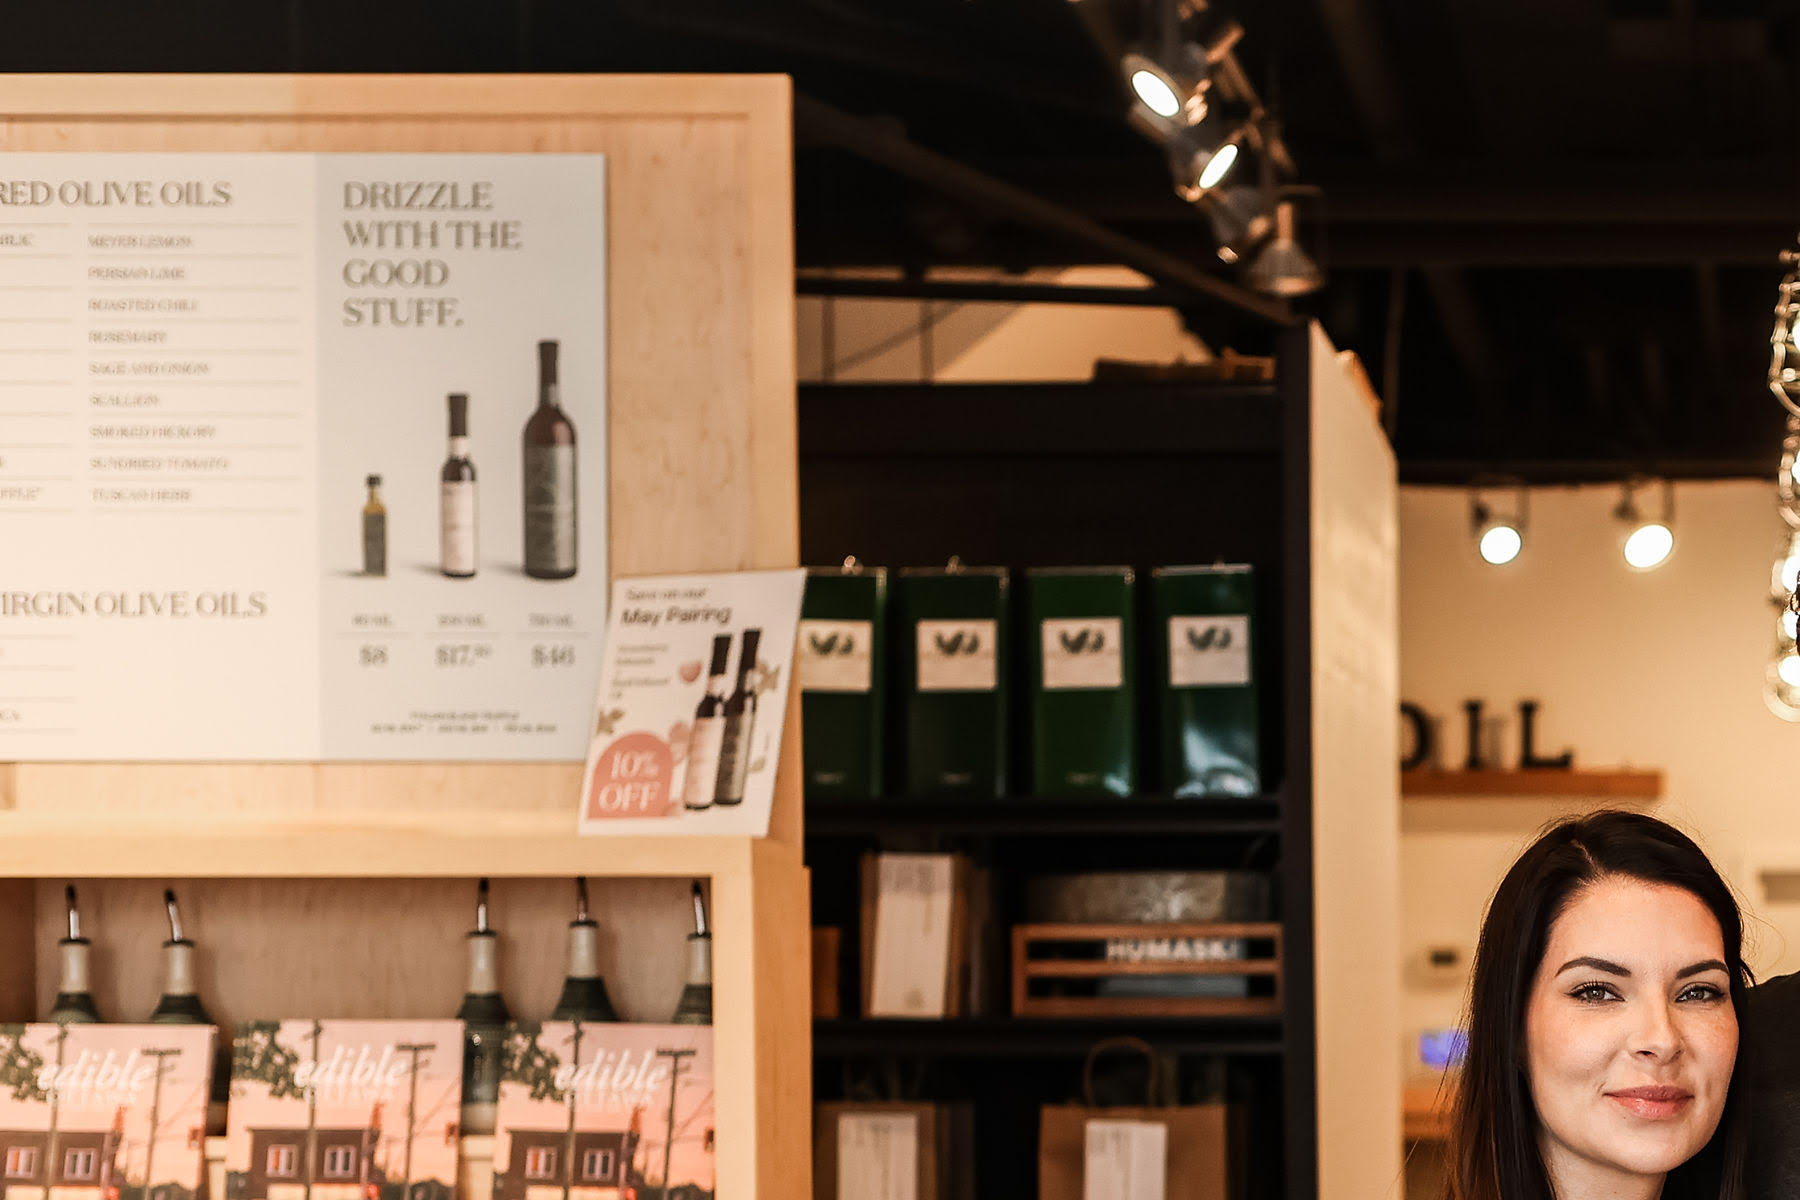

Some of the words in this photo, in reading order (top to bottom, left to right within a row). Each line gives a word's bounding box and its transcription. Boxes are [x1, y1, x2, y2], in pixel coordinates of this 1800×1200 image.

[58, 181, 153, 207] OLIVE
[160, 181, 233, 207] OILS
[344, 181, 494, 211] DRIZZLE
[344, 220, 440, 249] WITH
[446, 220, 522, 249] THE
[342, 258, 449, 289] GOOD
[343, 298, 464, 327] STUFF.
[94, 591, 190, 618] OLIVE
[196, 591, 269, 618] OILS
[621, 610, 660, 627] May
[666, 605, 732, 625] Pairing
[611, 750, 659, 778] 10%
[600, 781, 661, 811] OFF
[37, 1048, 154, 1091] edible
[294, 1045, 408, 1088] edible
[554, 1048, 668, 1091] edible
